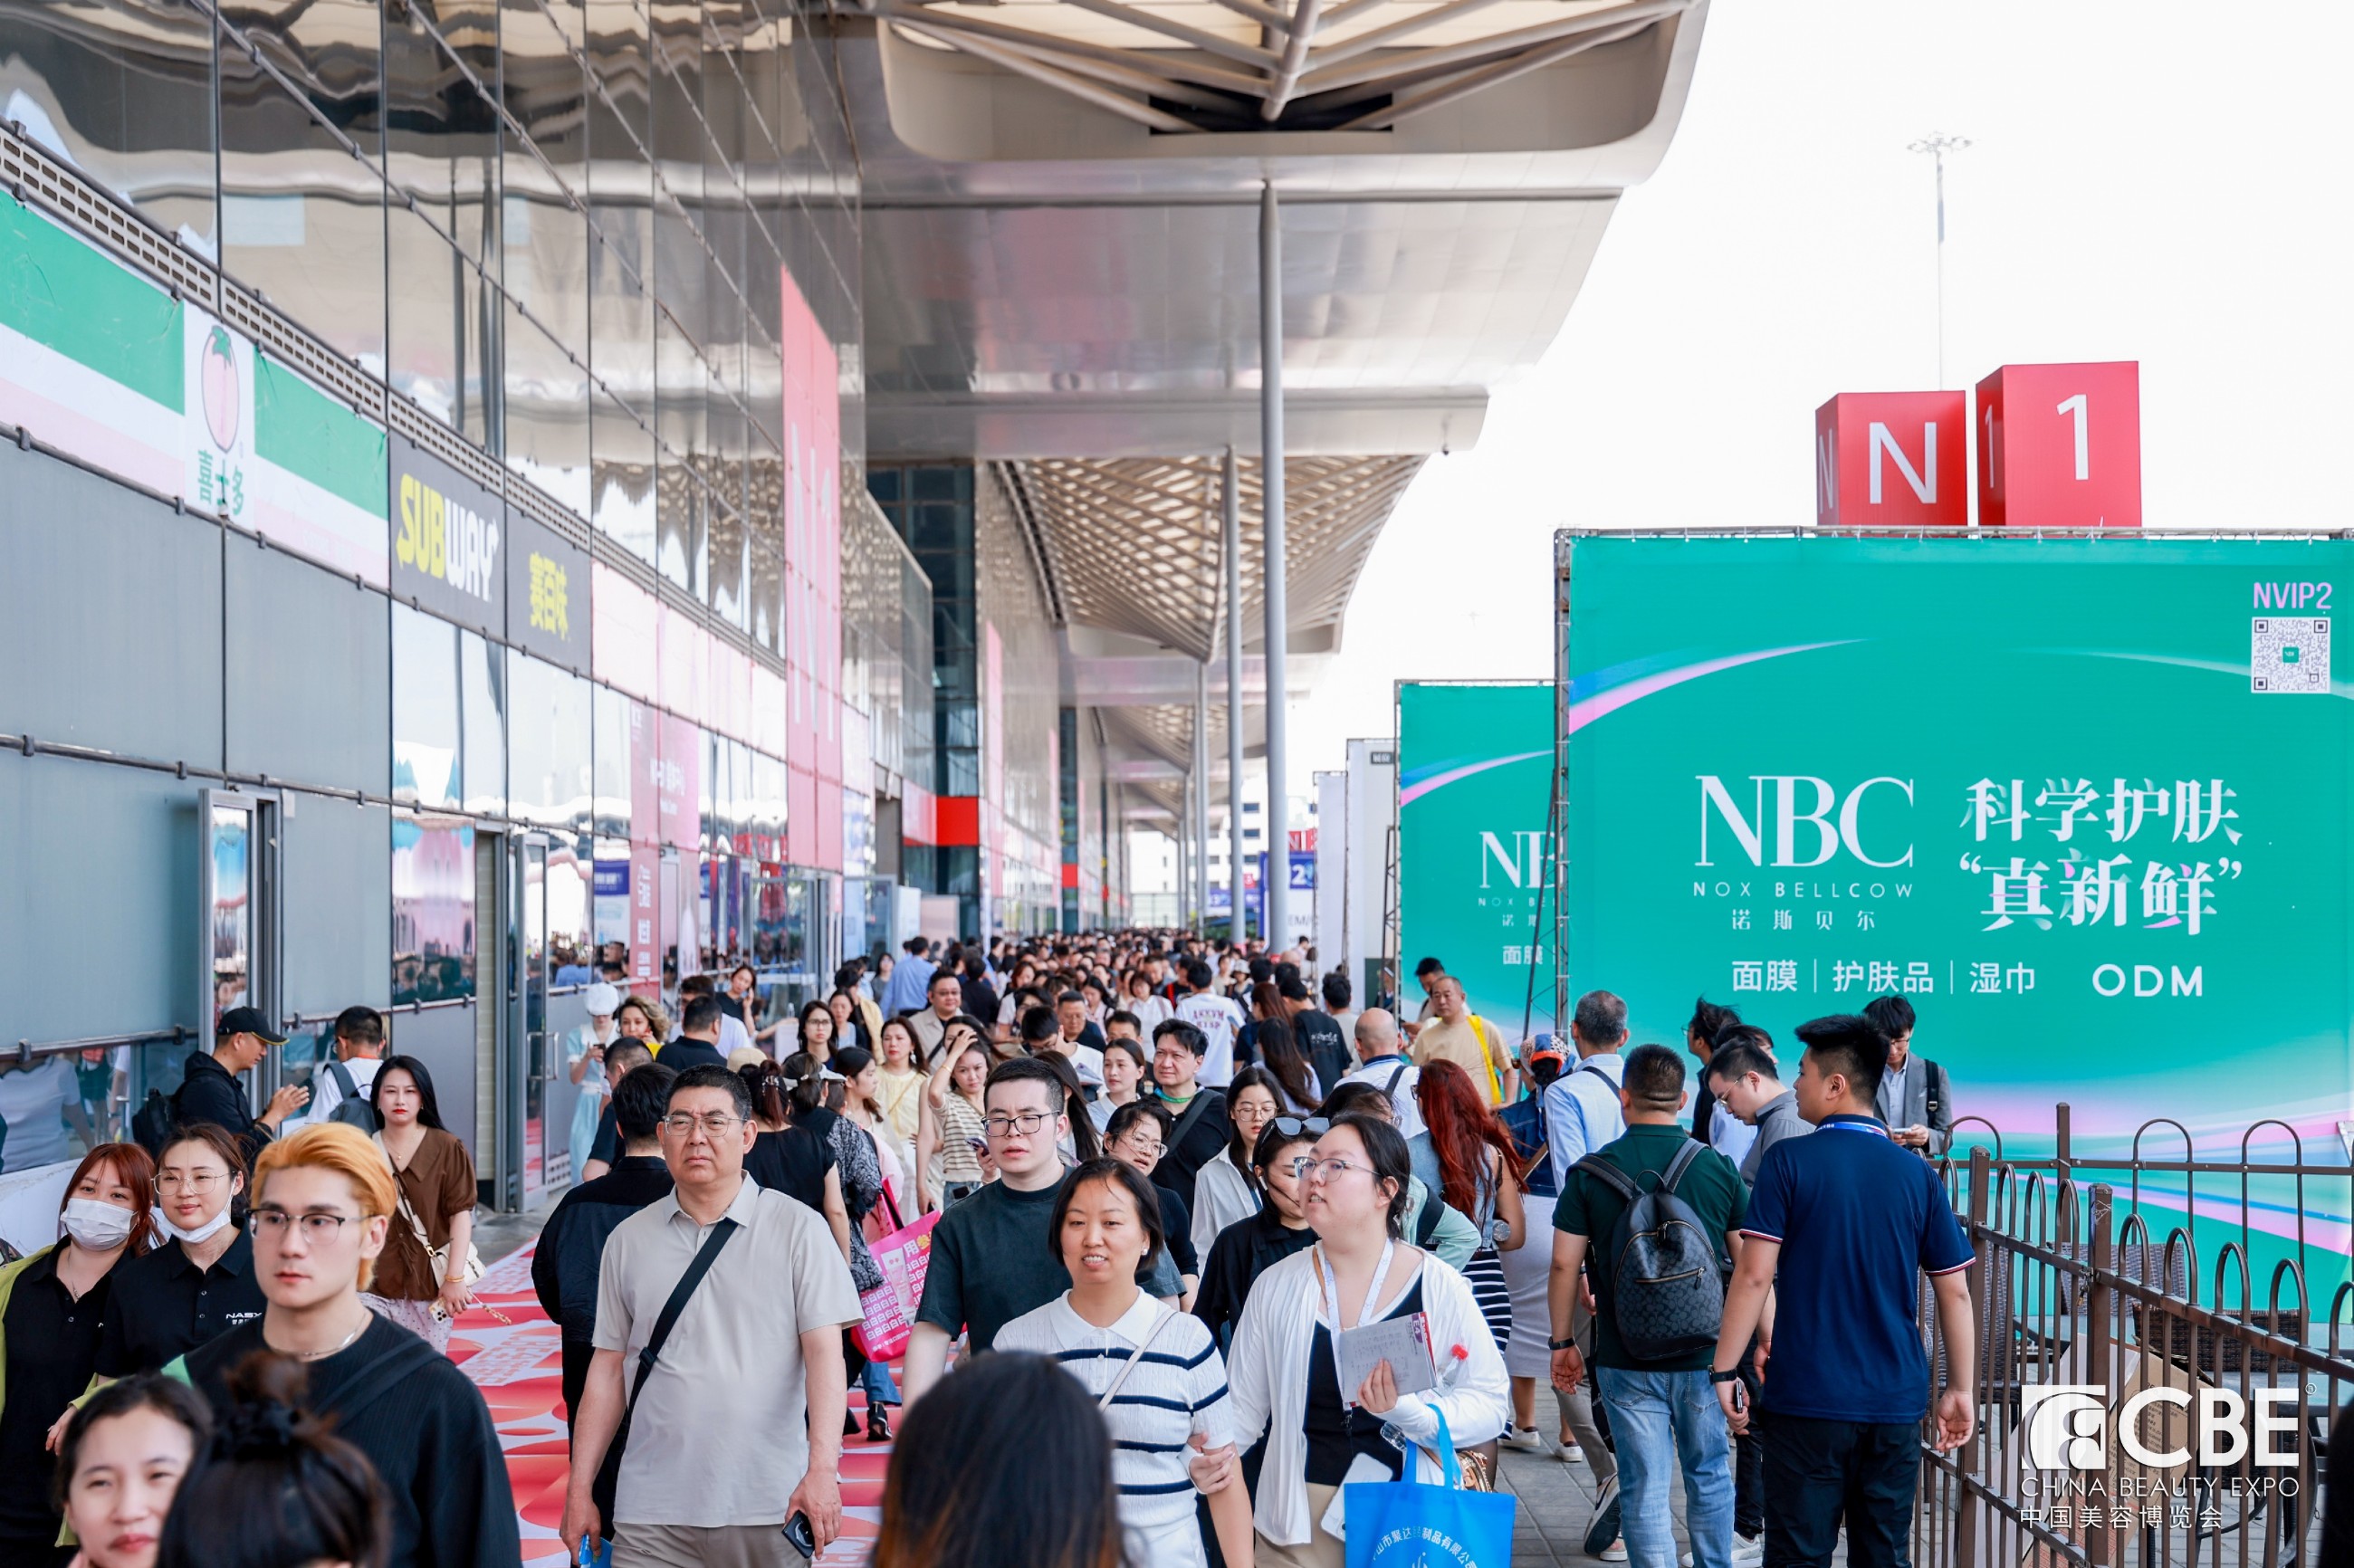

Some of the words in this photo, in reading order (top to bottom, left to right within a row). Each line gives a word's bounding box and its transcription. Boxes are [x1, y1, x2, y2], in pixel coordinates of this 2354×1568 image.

[1818, 429, 1833, 514] N
[1869, 422, 1938, 503] N
[1985, 405, 1995, 488] 1
[2056, 394, 2089, 480] 1
[396, 473, 500, 603] SUBWAY
[529, 550, 569, 641] 赛百味
[2253, 581, 2333, 609] NVIP2
[1694, 775, 1914, 868] NBC
[1959, 778, 2244, 846] 科学护肤
[1694, 882, 1751, 897] NOX
[1775, 882, 1913, 898] BELLCOW
[1731, 909, 1876, 931] 诺斯贝尔
[1732, 960, 1798, 993] 面膜
[1832, 960, 1935, 994] 护肤品
[1969, 961, 2036, 994] 湿巾
[2092, 964, 2204, 998] ODM
